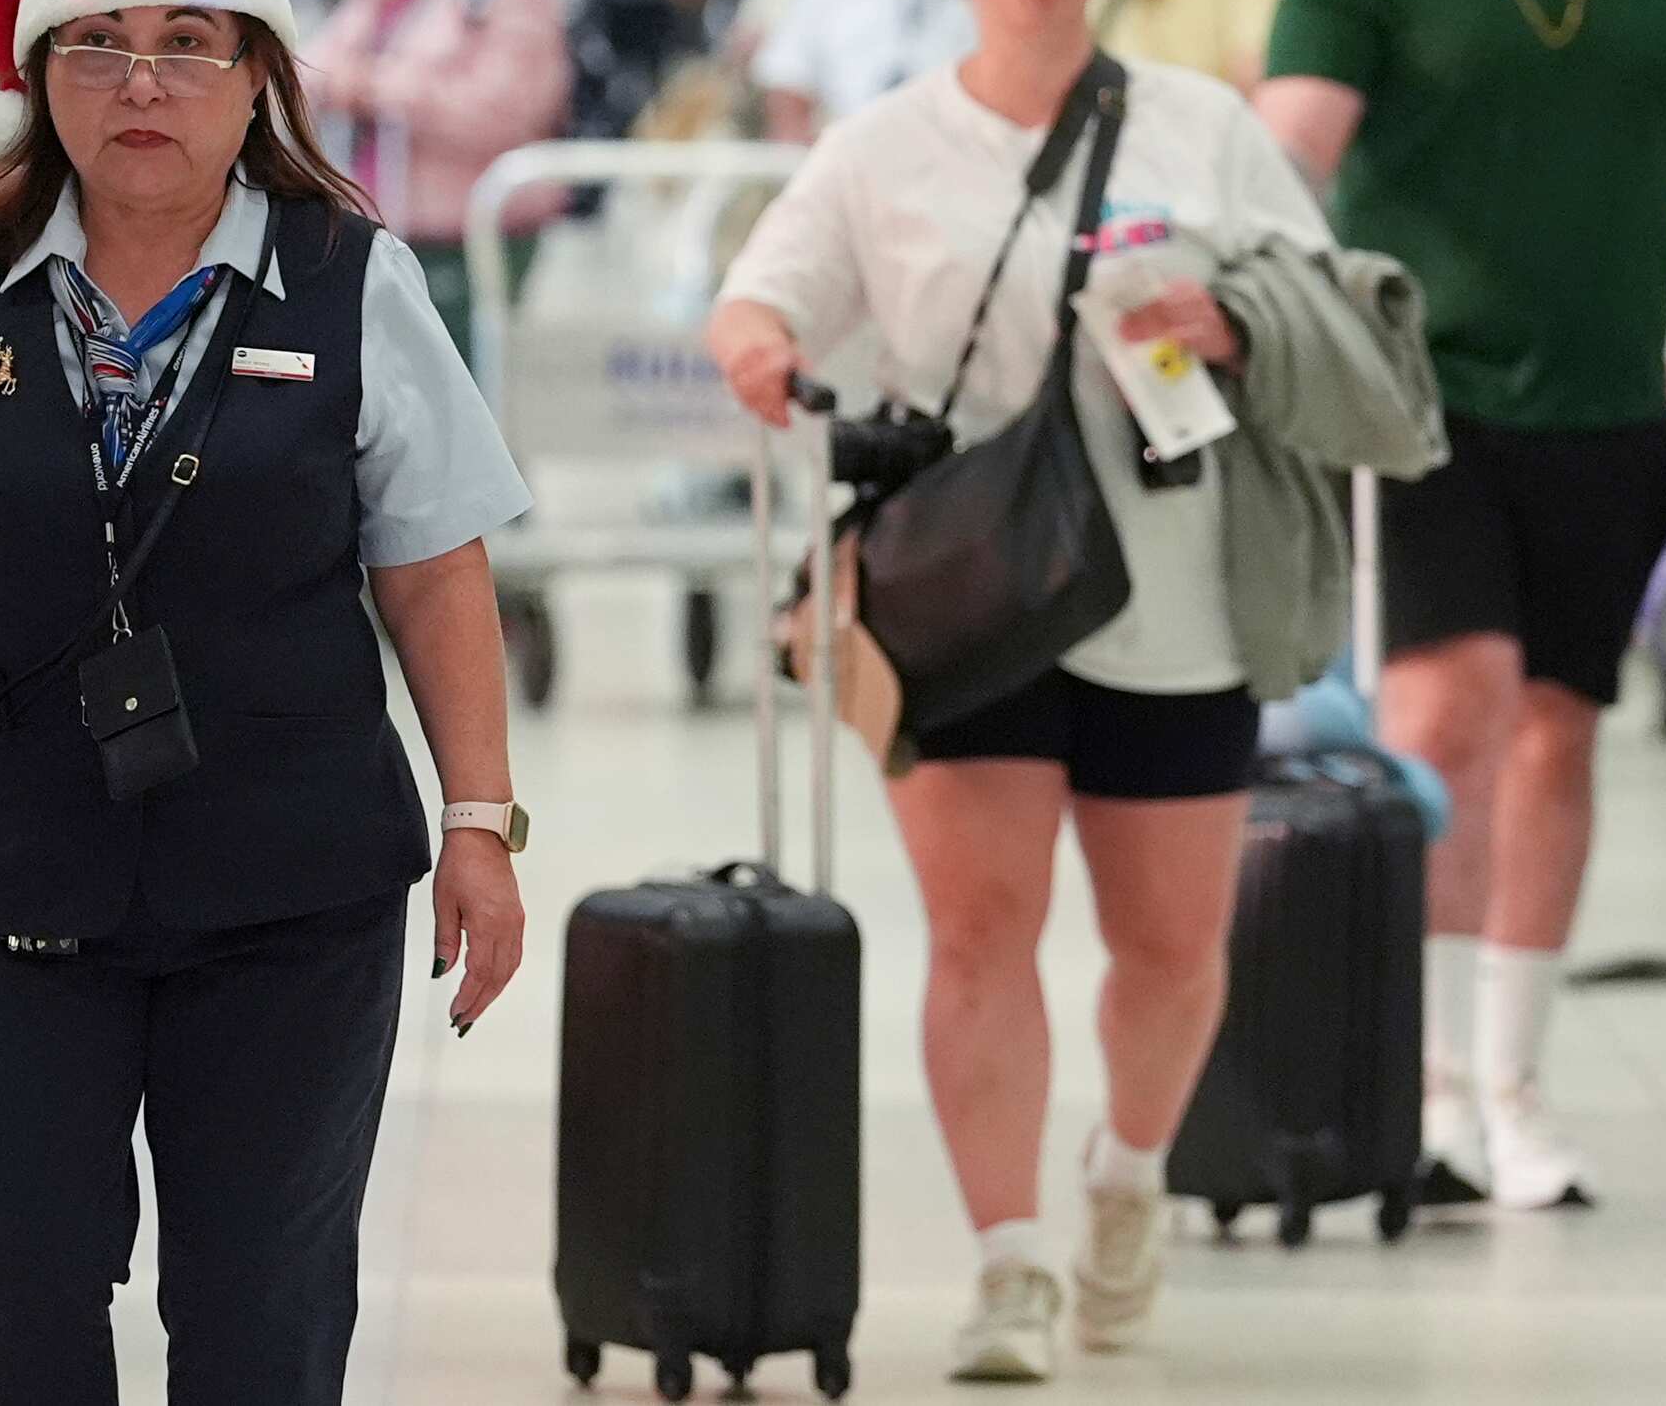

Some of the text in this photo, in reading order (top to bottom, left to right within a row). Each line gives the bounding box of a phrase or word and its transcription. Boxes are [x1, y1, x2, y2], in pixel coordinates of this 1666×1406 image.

[90, 443, 109, 491] oneworld
[116, 407, 160, 488] American Airlines
